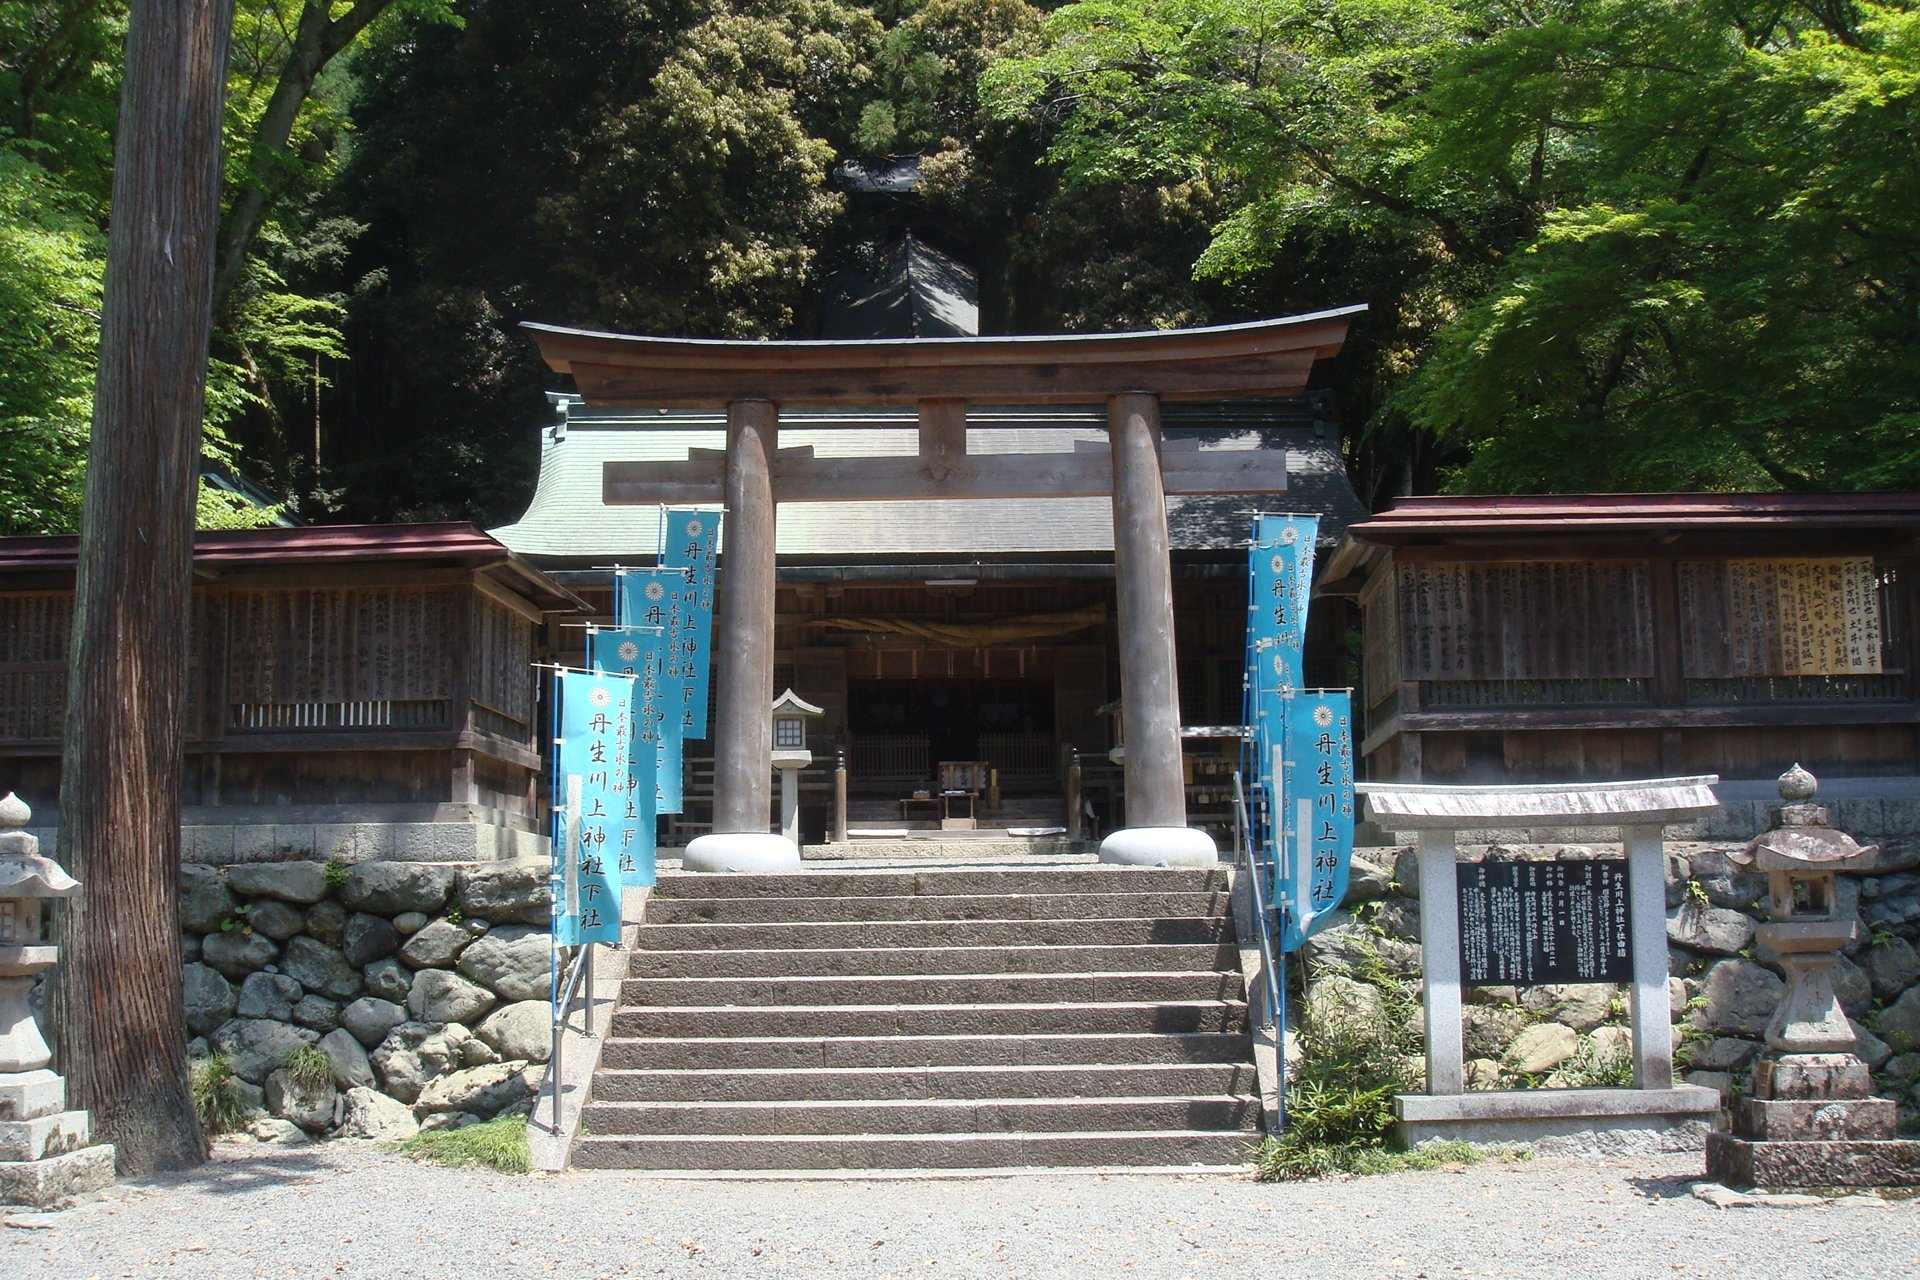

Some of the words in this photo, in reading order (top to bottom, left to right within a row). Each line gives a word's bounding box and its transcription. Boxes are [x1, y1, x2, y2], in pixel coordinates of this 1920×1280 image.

[580, 712, 613, 930] 丹生川上神社下社
[1313, 732, 1338, 913] 丹生川上神社
[1558, 891, 1566, 926] 六月一日
